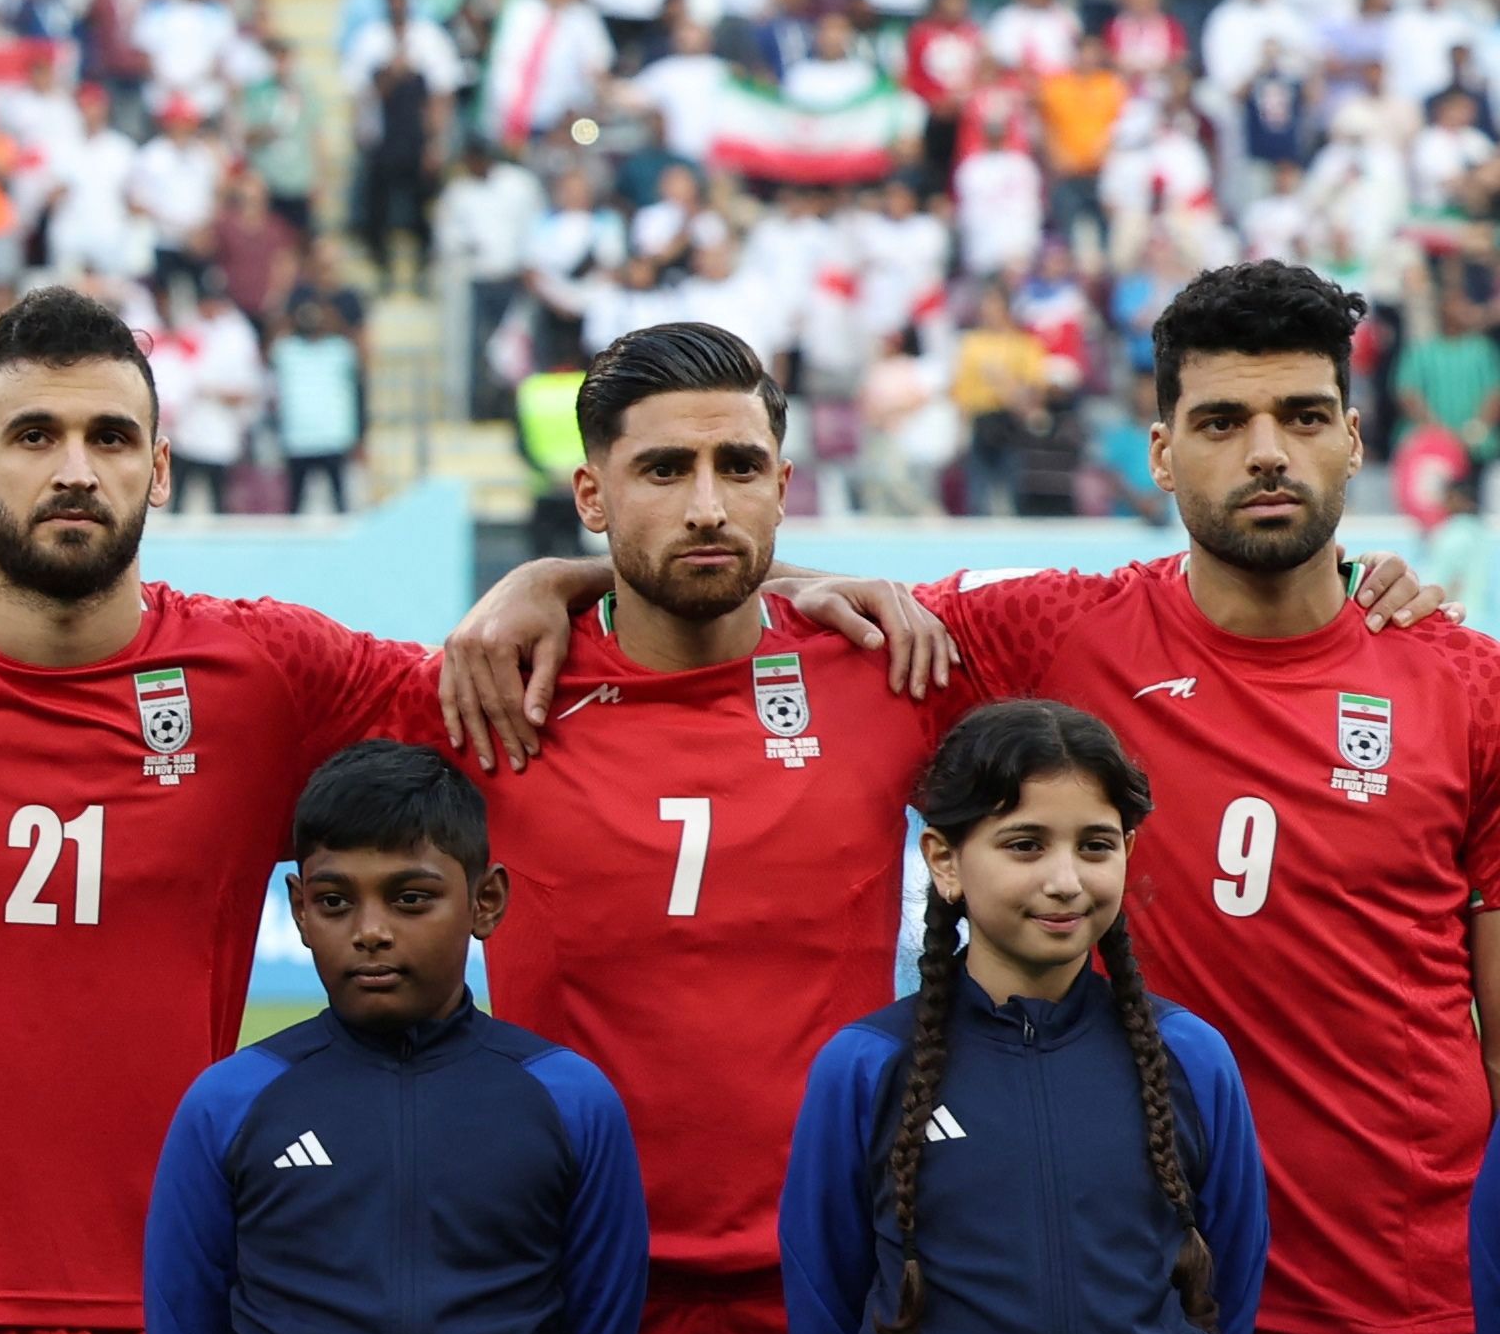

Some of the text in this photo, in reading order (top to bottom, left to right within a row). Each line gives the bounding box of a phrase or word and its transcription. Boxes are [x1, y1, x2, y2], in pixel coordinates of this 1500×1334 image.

[4, 804, 105, 926] 21
[658, 797, 712, 917] 7
[1212, 796, 1278, 917] 9
